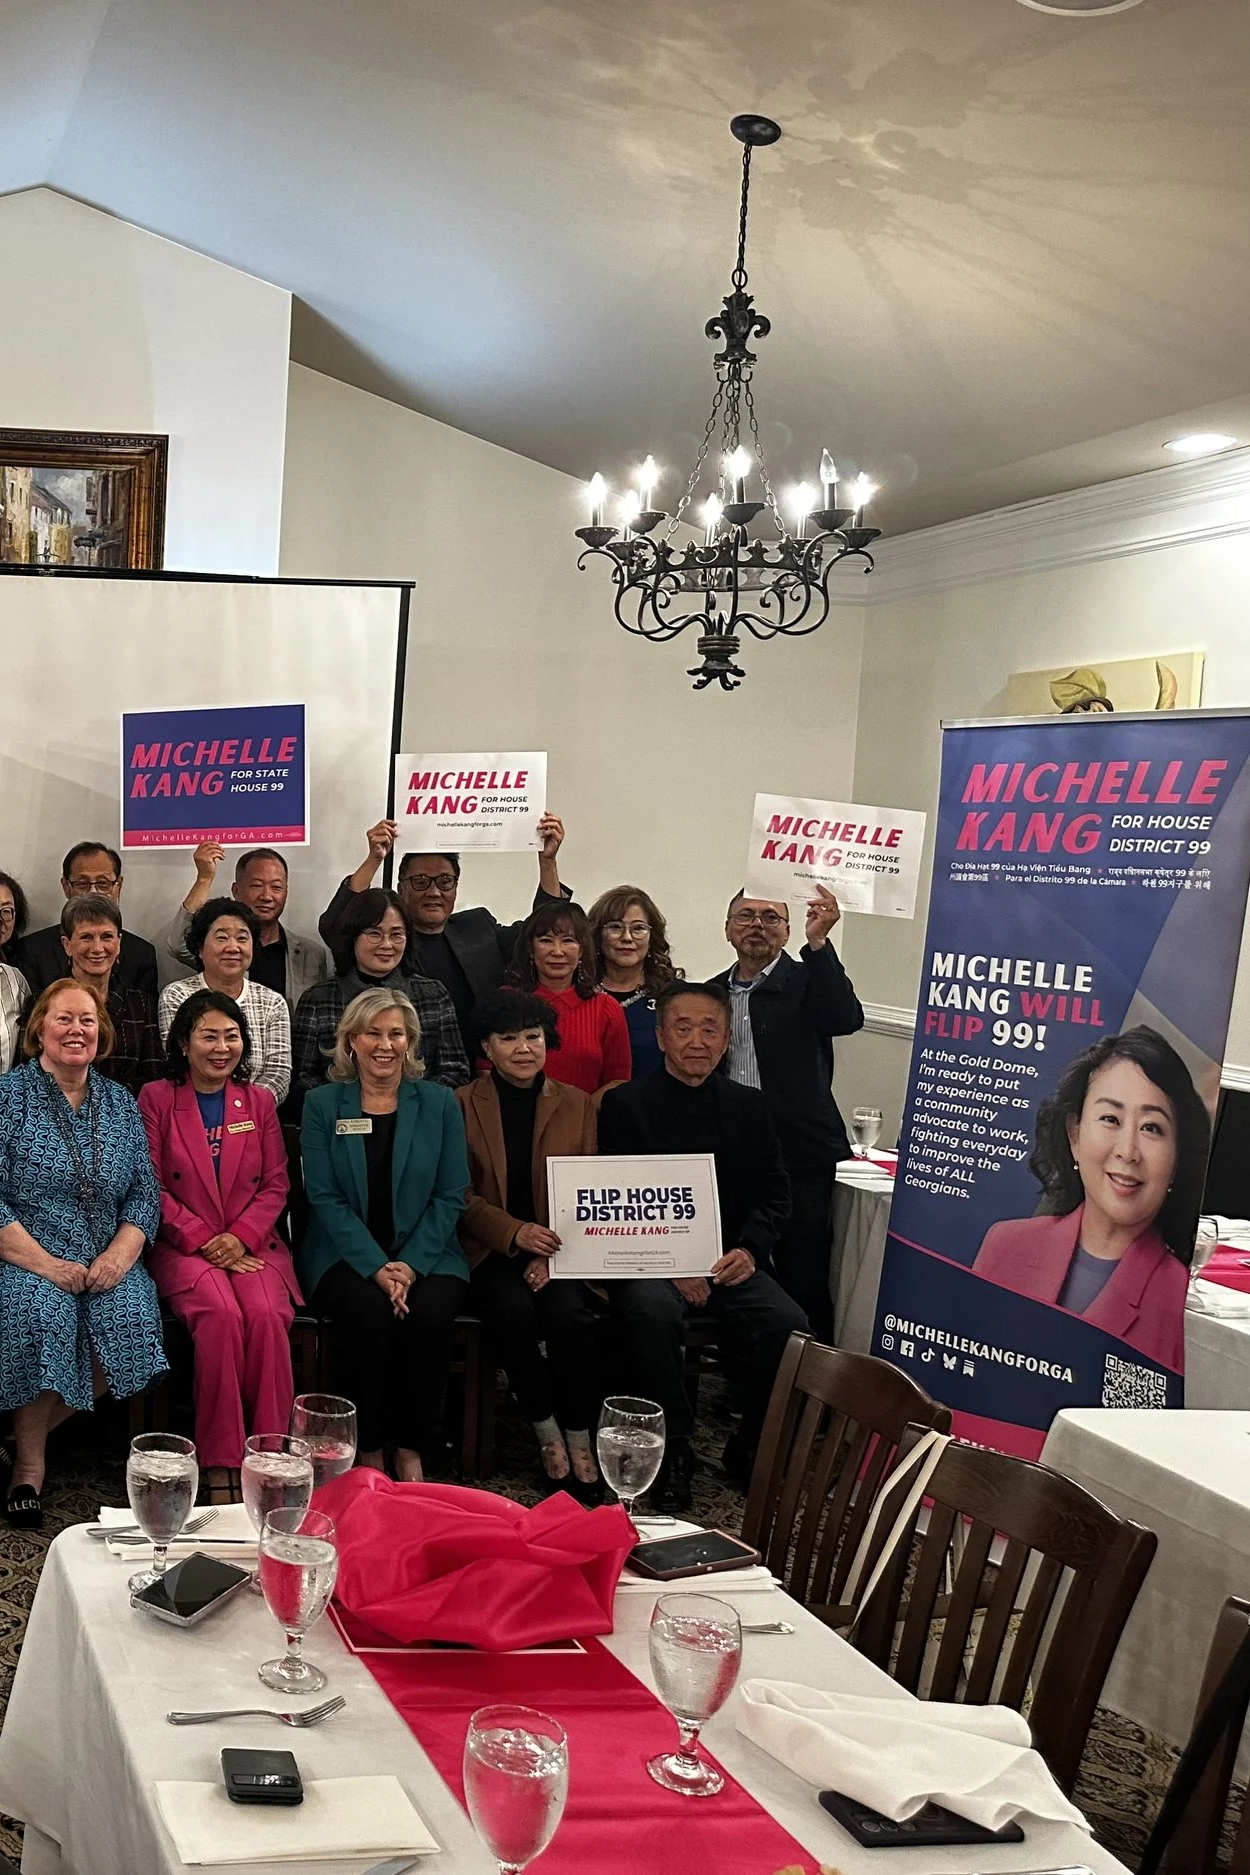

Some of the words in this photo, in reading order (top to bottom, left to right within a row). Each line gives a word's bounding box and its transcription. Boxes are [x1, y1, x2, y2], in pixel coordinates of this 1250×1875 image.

[130, 736, 298, 768] MICHELLE
[130, 770, 224, 798] KANG
[230, 770, 253, 779] FOR
[255, 768, 289, 778] STATE
[408, 771, 529, 790] MICHELLE
[961, 760, 1228, 805] MICHELLE
[230, 783, 268, 792] HOUSE
[270, 782, 284, 791] 99
[406, 795, 478, 815] KANG
[766, 814, 903, 848] MICHELLE
[955, 812, 1103, 855] KANG
[1111, 814, 1143, 829] FOR
[1146, 815, 1212, 830] HOUSE
[142, 832, 284, 842] MichelleKangforGA.com
[1109, 838, 1182, 853] DISTRICT
[1187, 841, 1211, 854] 99
[761, 839, 843, 867] KANG
[846, 851, 866, 859] FOR
[867, 853, 900, 863] HOUSE
[845, 862, 887, 873] DISTRICT
[888, 866, 900, 875] 99
[951, 862, 964, 870] Cho
[1068, 865, 1091, 875] Bang
[1005, 874, 1023, 882] Para
[1033, 875, 1063, 883] Distrito
[1064, 876, 1075, 884] 99
[1077, 877, 1088, 885] de
[1090, 877, 1097, 885] la
[931, 951, 1093, 993] MICHELLE
[927, 981, 1011, 1015] KANG
[1020, 991, 1105, 1027] WILL
[924, 1010, 984, 1041] FLIP
[991, 1019, 1047, 1051] 99!
[920, 1048, 933, 1060] At
[935, 1051, 956, 1063] the
[958, 1054, 990, 1069] Gold
[992, 1059, 1039, 1078] Dome,
[938, 1068, 976, 1085] ready
[978, 1074, 992, 1086] to
[994, 1078, 1021, 1090] put
[916, 1081, 935, 1094] my
[936, 1084, 1009, 1105] experience
[1011, 1098, 1030, 1109] as
[915, 1097, 922, 1106] a
[924, 1098, 998, 1122] community
[913, 1112, 970, 1131] advocate
[972, 1123, 986, 1135] to
[989, 1127, 1029, 1145] work,
[910, 1126, 960, 1148] fighting
[962, 1138, 1028, 1161] everyday
[908, 1143, 920, 1154] to
[921, 1144, 975, 1166] improve
[977, 1157, 1001, 1171] the
[906, 1158, 932, 1173] lives
[934, 1165, 951, 1177] of
[949, 1169, 975, 1183] ALL
[576, 1188, 621, 1205] FLIP
[626, 1187, 693, 1204] HOUSE
[904, 1174, 970, 1198] Georgians.
[576, 1204, 668, 1221] DISTRICT
[673, 1203, 696, 1220] 99
[584, 1226, 638, 1236] MICHELLE
[641, 1226, 669, 1235] KANG
[884, 1314, 1074, 1384] @MICHELLEKANGFORGA
